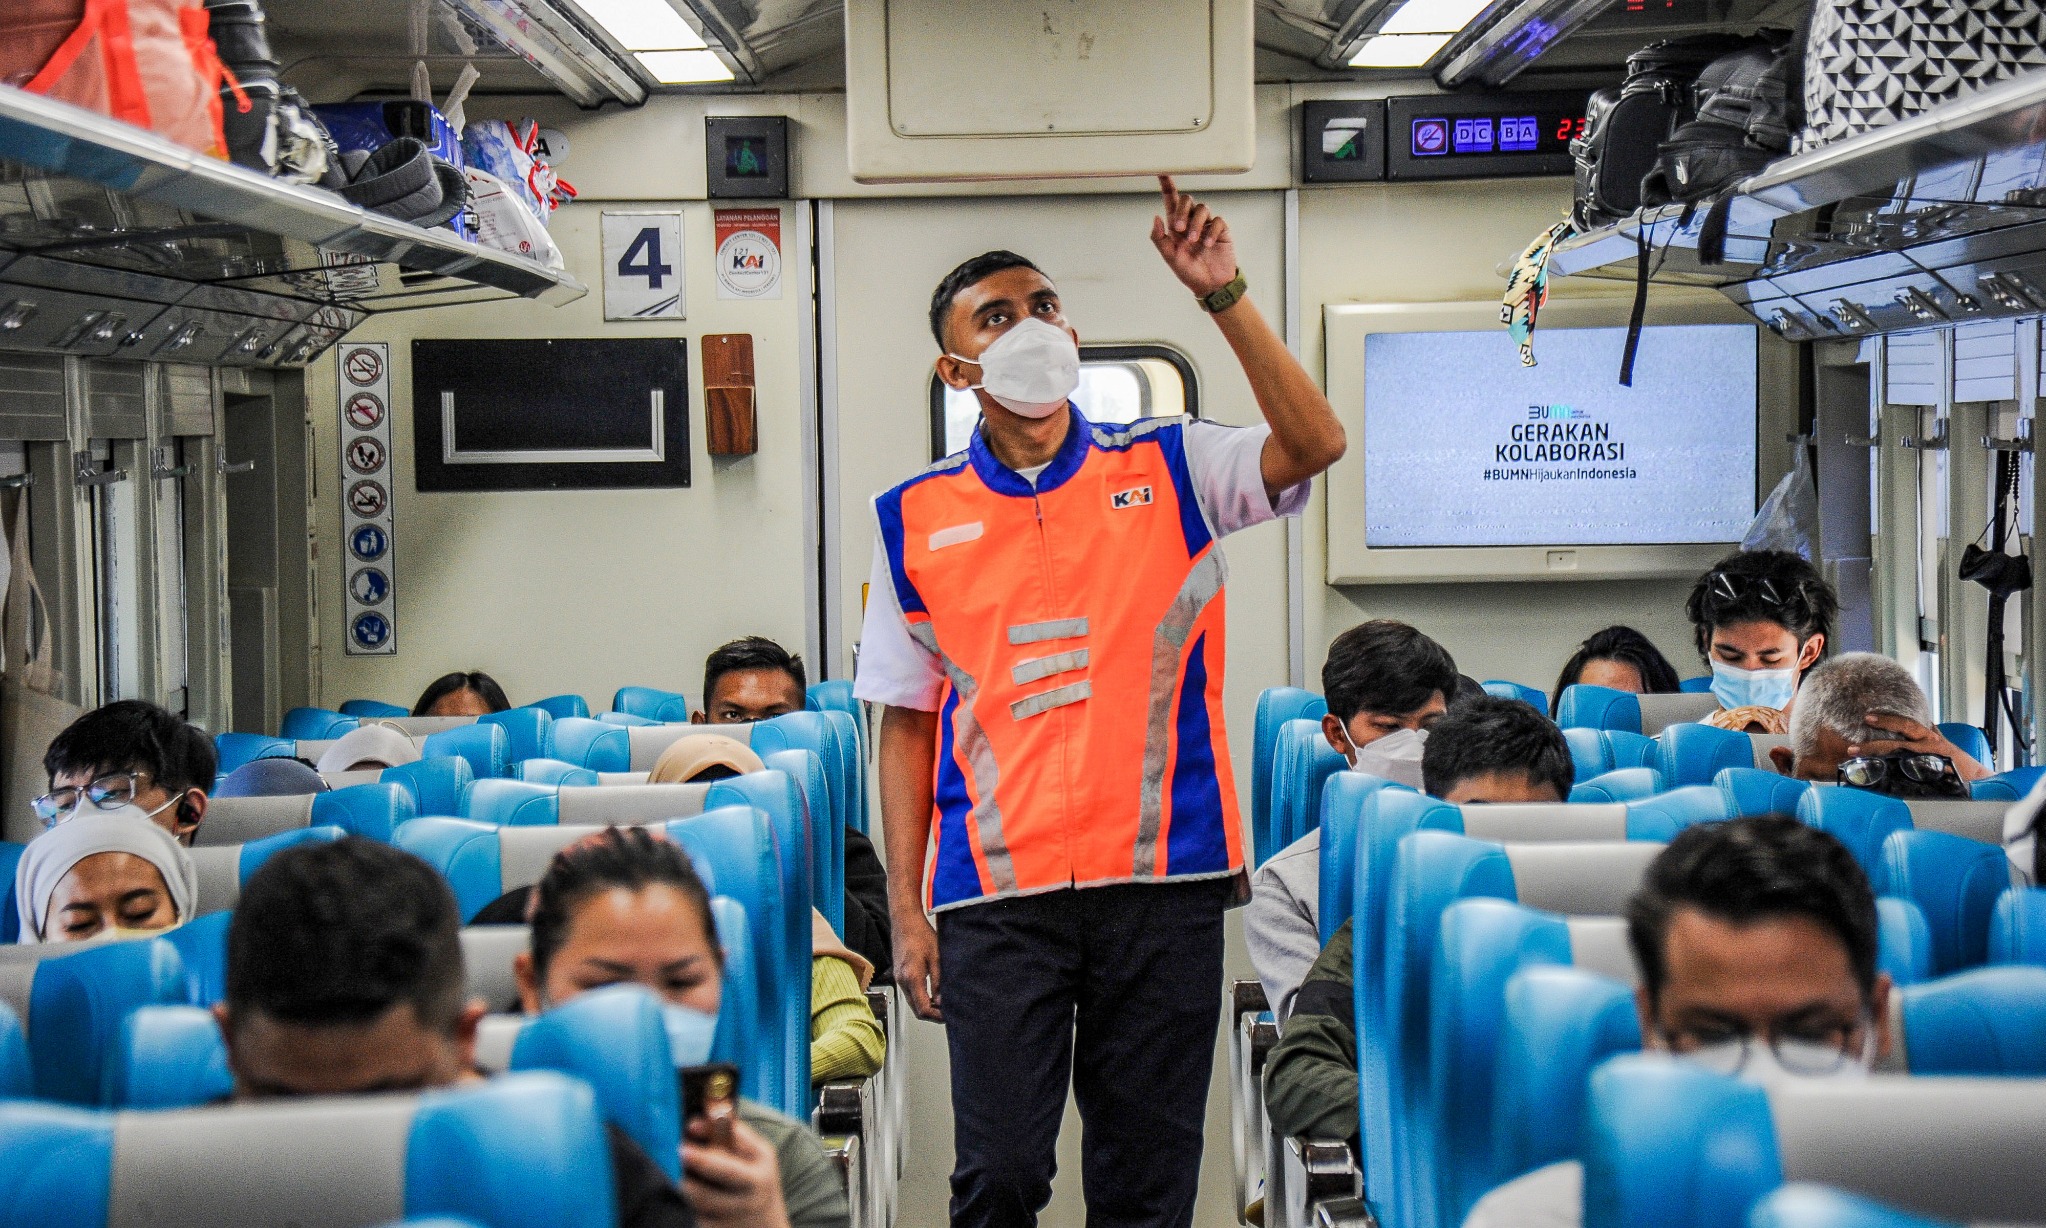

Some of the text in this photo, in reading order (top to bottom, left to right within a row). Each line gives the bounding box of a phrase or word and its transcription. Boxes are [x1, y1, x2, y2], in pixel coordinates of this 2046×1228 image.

[1460, 129, 1470, 140] D
[1478, 128, 1488, 139] C
[1505, 127, 1514, 138] B
[1522, 126, 1532, 138] A
[618, 228, 672, 289] 4
[1511, 422, 1609, 442] GERAKAN
[1496, 442, 1624, 462] KOLABORASI
[1483, 467, 1636, 483] #BUMNHijaukanIndonesia
